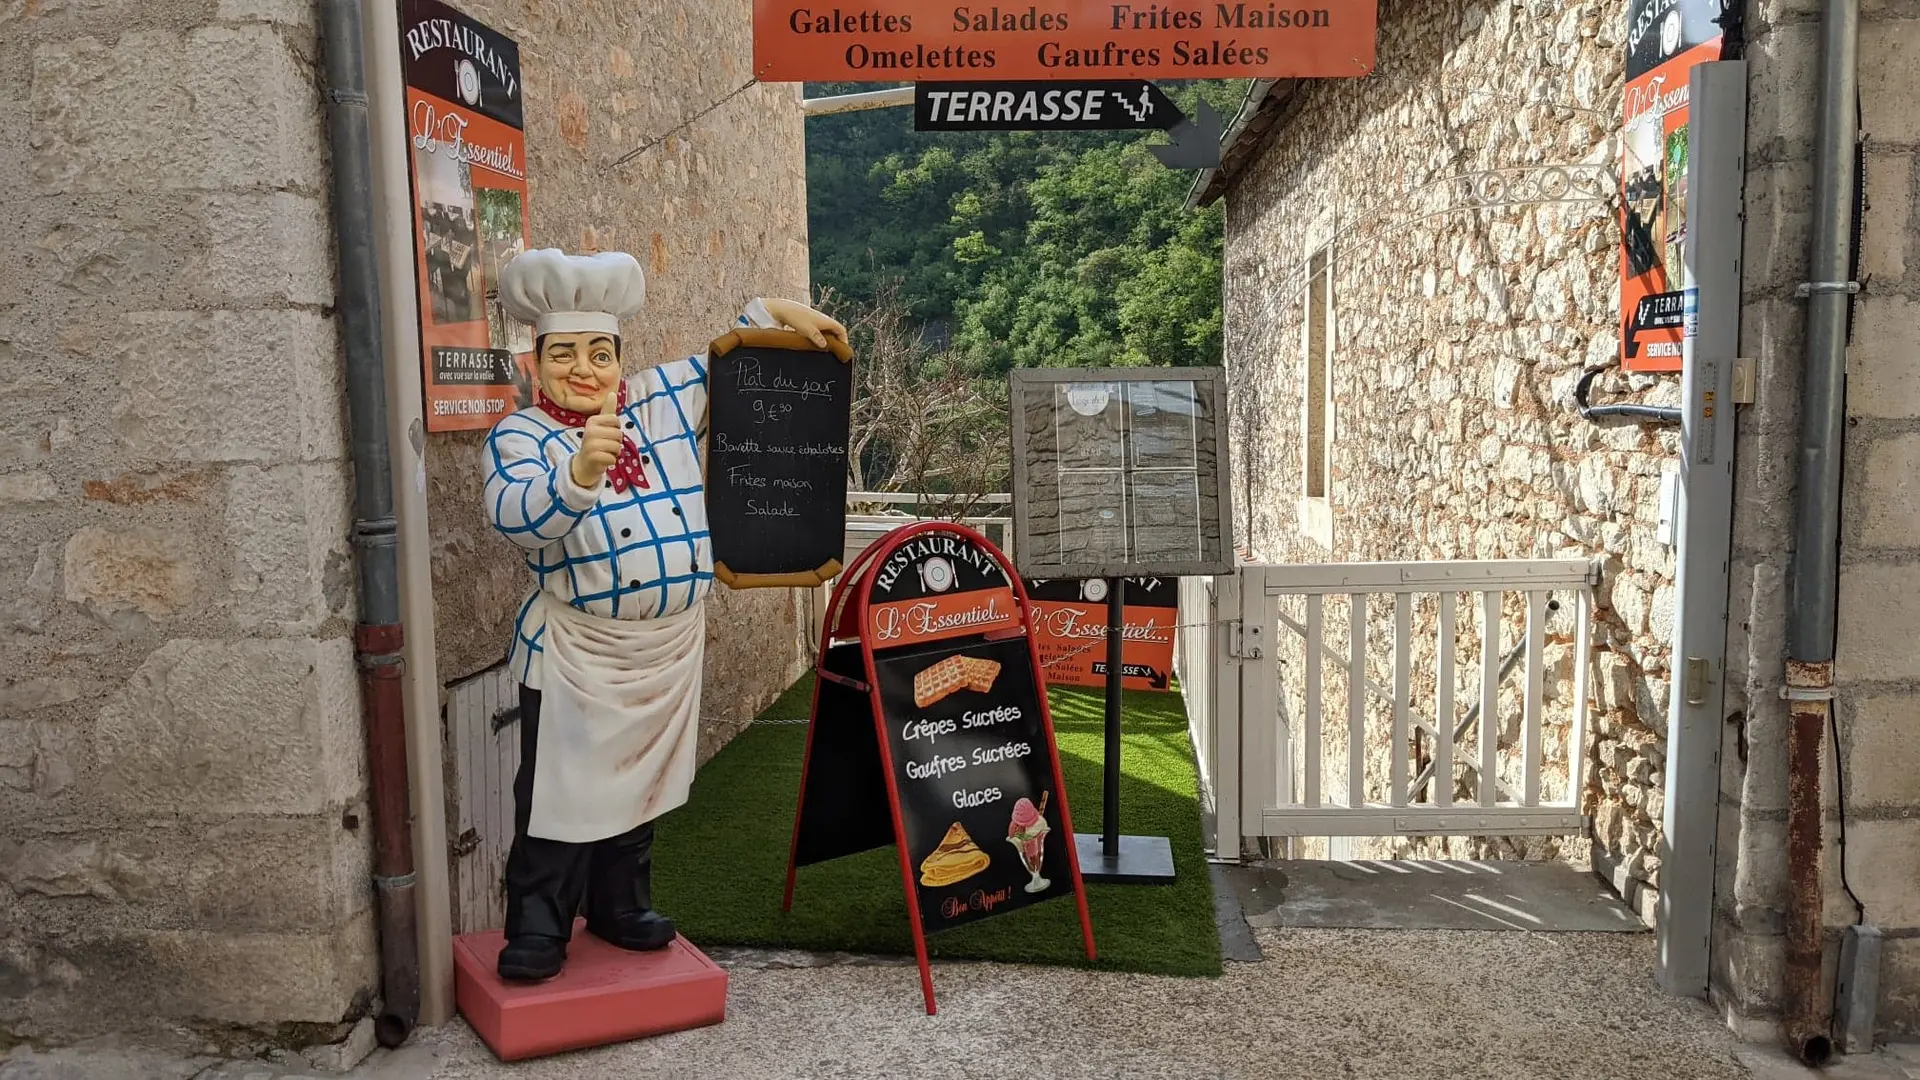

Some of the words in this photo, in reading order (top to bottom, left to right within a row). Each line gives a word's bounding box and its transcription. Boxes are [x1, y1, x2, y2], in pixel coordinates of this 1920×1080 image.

[789, 8, 912, 34] Galettes
[953, 6, 1069, 33] Salades
[1110, 4, 1202, 31] Frites
[1214, 3, 1330, 30] Maison
[406, 18, 518, 100] RESTAURANT
[845, 43, 996, 69] Omelettes
[1037, 41, 1160, 68] Gaufres
[1172, 39, 1269, 66] Salées
[926, 90, 1106, 122] TERRASSE
[1654, 295, 1684, 313] TERRA
[438, 351, 495, 369] TERRASSE
[1647, 342, 1672, 357] SERVICE
[728, 356, 767, 387] Plat
[773, 368, 799, 389] du
[802, 377, 836, 401] jour
[434, 400, 467, 415] SERVICE
[468, 400, 486, 413] NON
[487, 399, 505, 413] STOP
[715, 433, 762, 453] Bavette
[767, 444, 797, 455] sauce
[727, 464, 767, 487] Frites
[773, 478, 813, 490] maison
[745, 500, 800, 516] Salade
[876, 537, 996, 593] RESTAURANT
[902, 717, 957, 744] Crêpes
[962, 705, 1022, 729] Sucrées
[906, 753, 967, 780] Gaufres
[972, 742, 1031, 765] Sucrées
[952, 786, 1002, 809] Glaces
